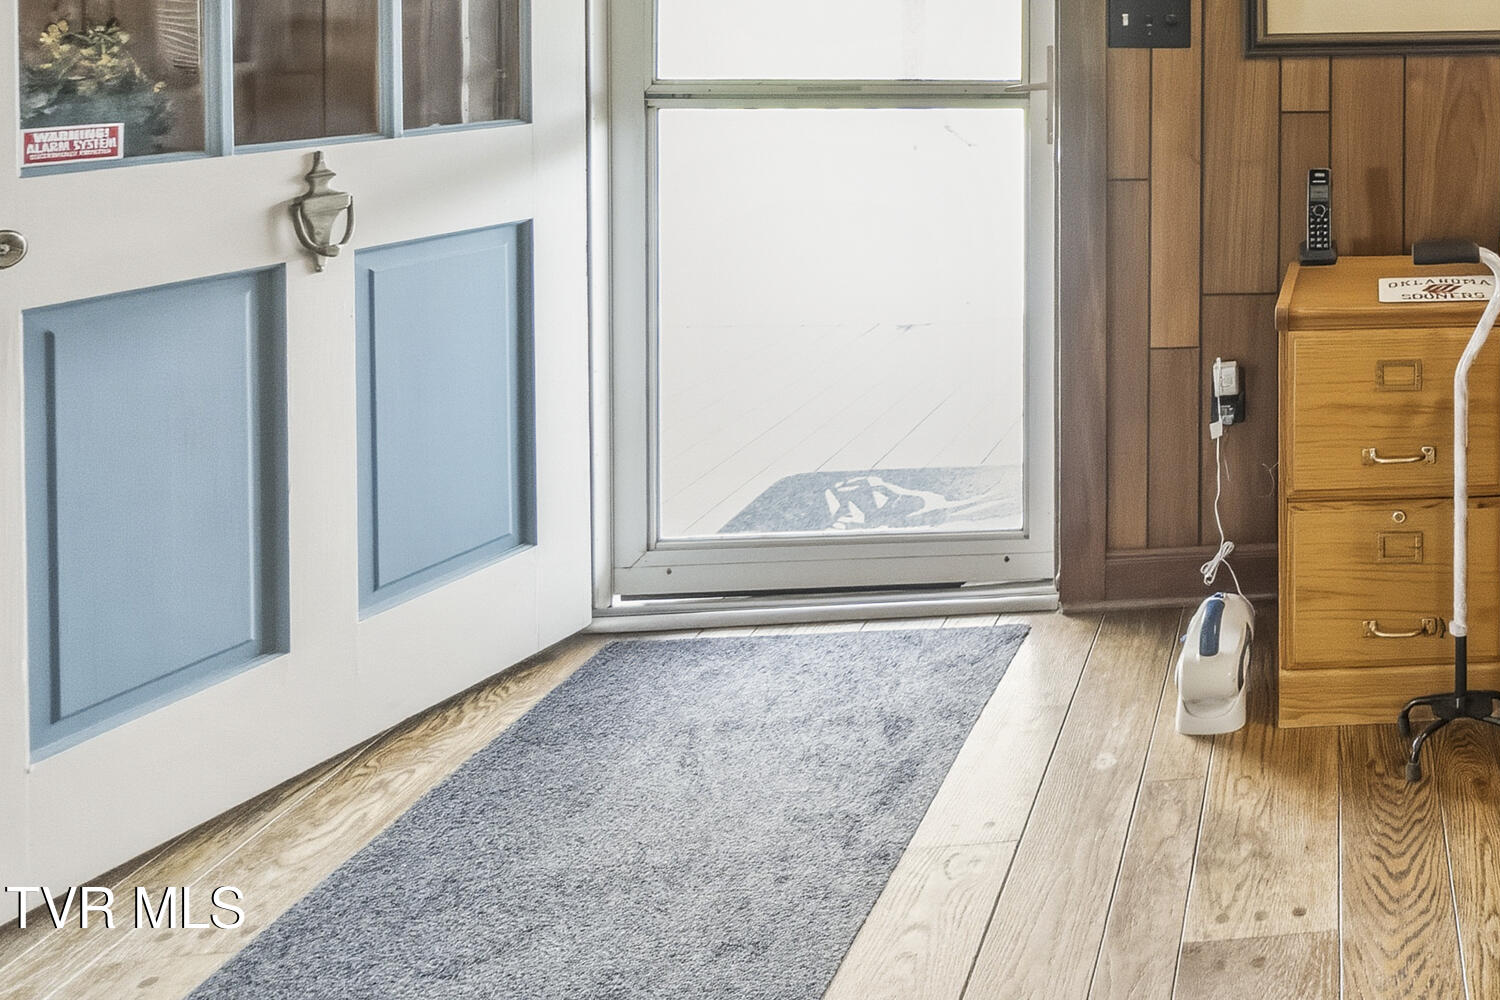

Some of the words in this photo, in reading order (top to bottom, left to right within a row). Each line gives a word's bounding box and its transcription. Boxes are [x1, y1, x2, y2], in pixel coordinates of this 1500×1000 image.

[33, 127, 110, 142] WARNING!
[26, 141, 70, 154] ALARM
[73, 137, 117, 150] SYSTEM
[1388, 278, 1492, 289] OKLAHOMA
[1401, 291, 1485, 300] SOONERS
